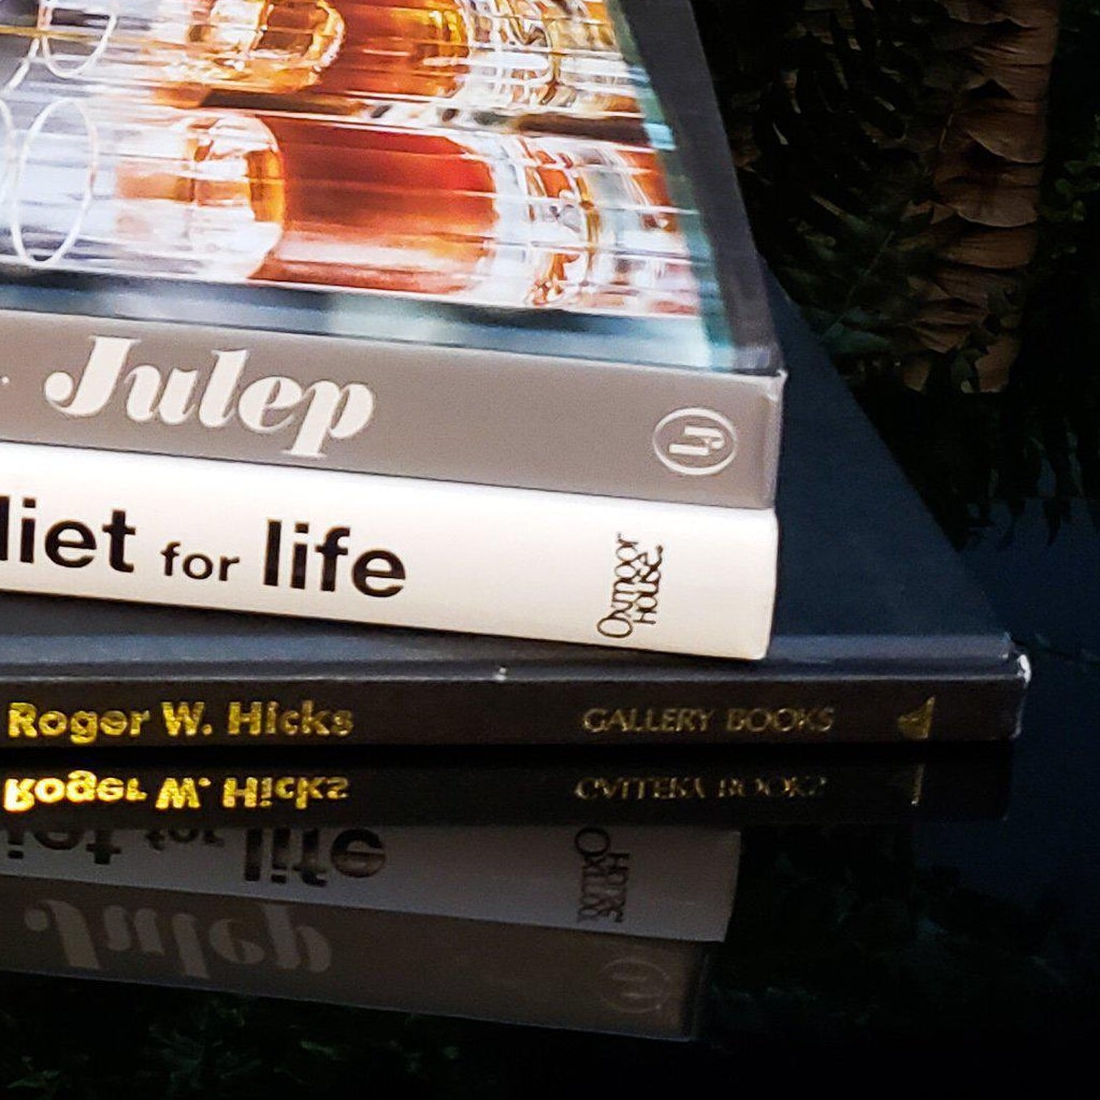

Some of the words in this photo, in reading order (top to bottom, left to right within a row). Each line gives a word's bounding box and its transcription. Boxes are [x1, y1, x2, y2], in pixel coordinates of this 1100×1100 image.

[43, 335, 376, 458] Julep
[161, 540, 241, 582] for
[262, 519, 408, 599] life
[6, 701, 150, 745] Roger
[160, 701, 214, 738] W.
[227, 701, 355, 738] Hicks
[582, 707, 715, 733] GALLERY
[725, 706, 836, 733] BOOKS
